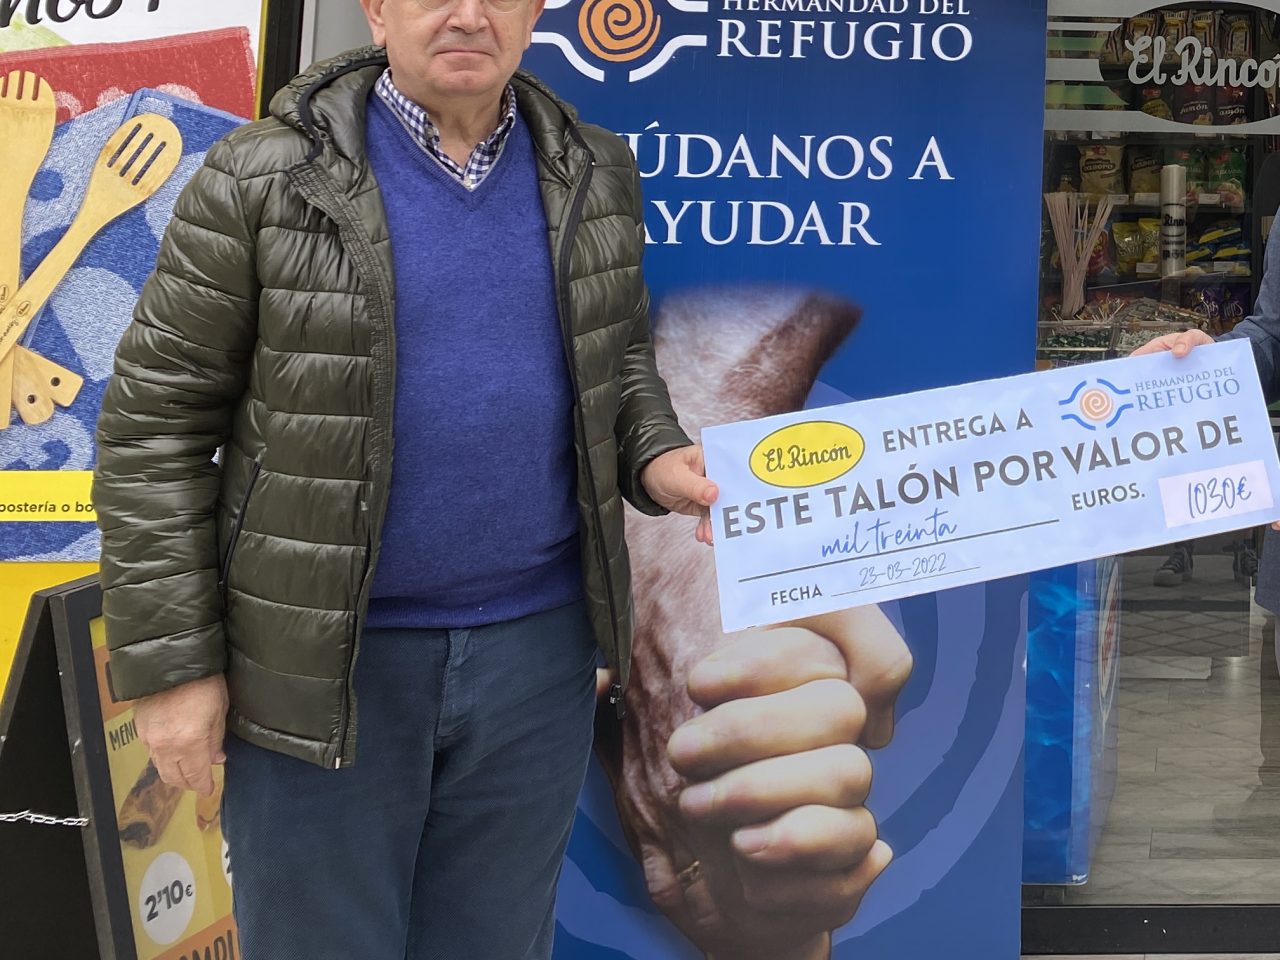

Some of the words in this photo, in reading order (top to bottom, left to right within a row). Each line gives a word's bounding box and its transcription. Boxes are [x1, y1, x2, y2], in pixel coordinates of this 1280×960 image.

[716, 18, 973, 62] REFUGIO
[1124, 35, 1168, 87] El
[908, 135, 955, 180] A
[1135, 371, 1209, 393] HERMANDAD
[1210, 366, 1236, 379] DEL
[1135, 377, 1241, 412] REFUGIO
[883, 414, 1000, 453] ENTREGA
[1015, 408, 1033, 431] A
[765, 437, 785, 471] El
[788, 442, 852, 468] Rincón
[723, 493, 812, 538] ESTE
[825, 464, 960, 518] TALÓN
[975, 450, 1057, 493] POR
[1060, 425, 1187, 474] VALOR
[1200, 414, 1243, 447] DE
[61, 504, 70, 512] o
[1071, 482, 1146, 511] EUROS.
[1187, 476, 1252, 518] 1030€
[822, 528, 870, 558] mil
[871, 507, 957, 545] treinta
[858, 552, 947, 587] 23-03-2022
[771, 584, 822, 605] FECHA
